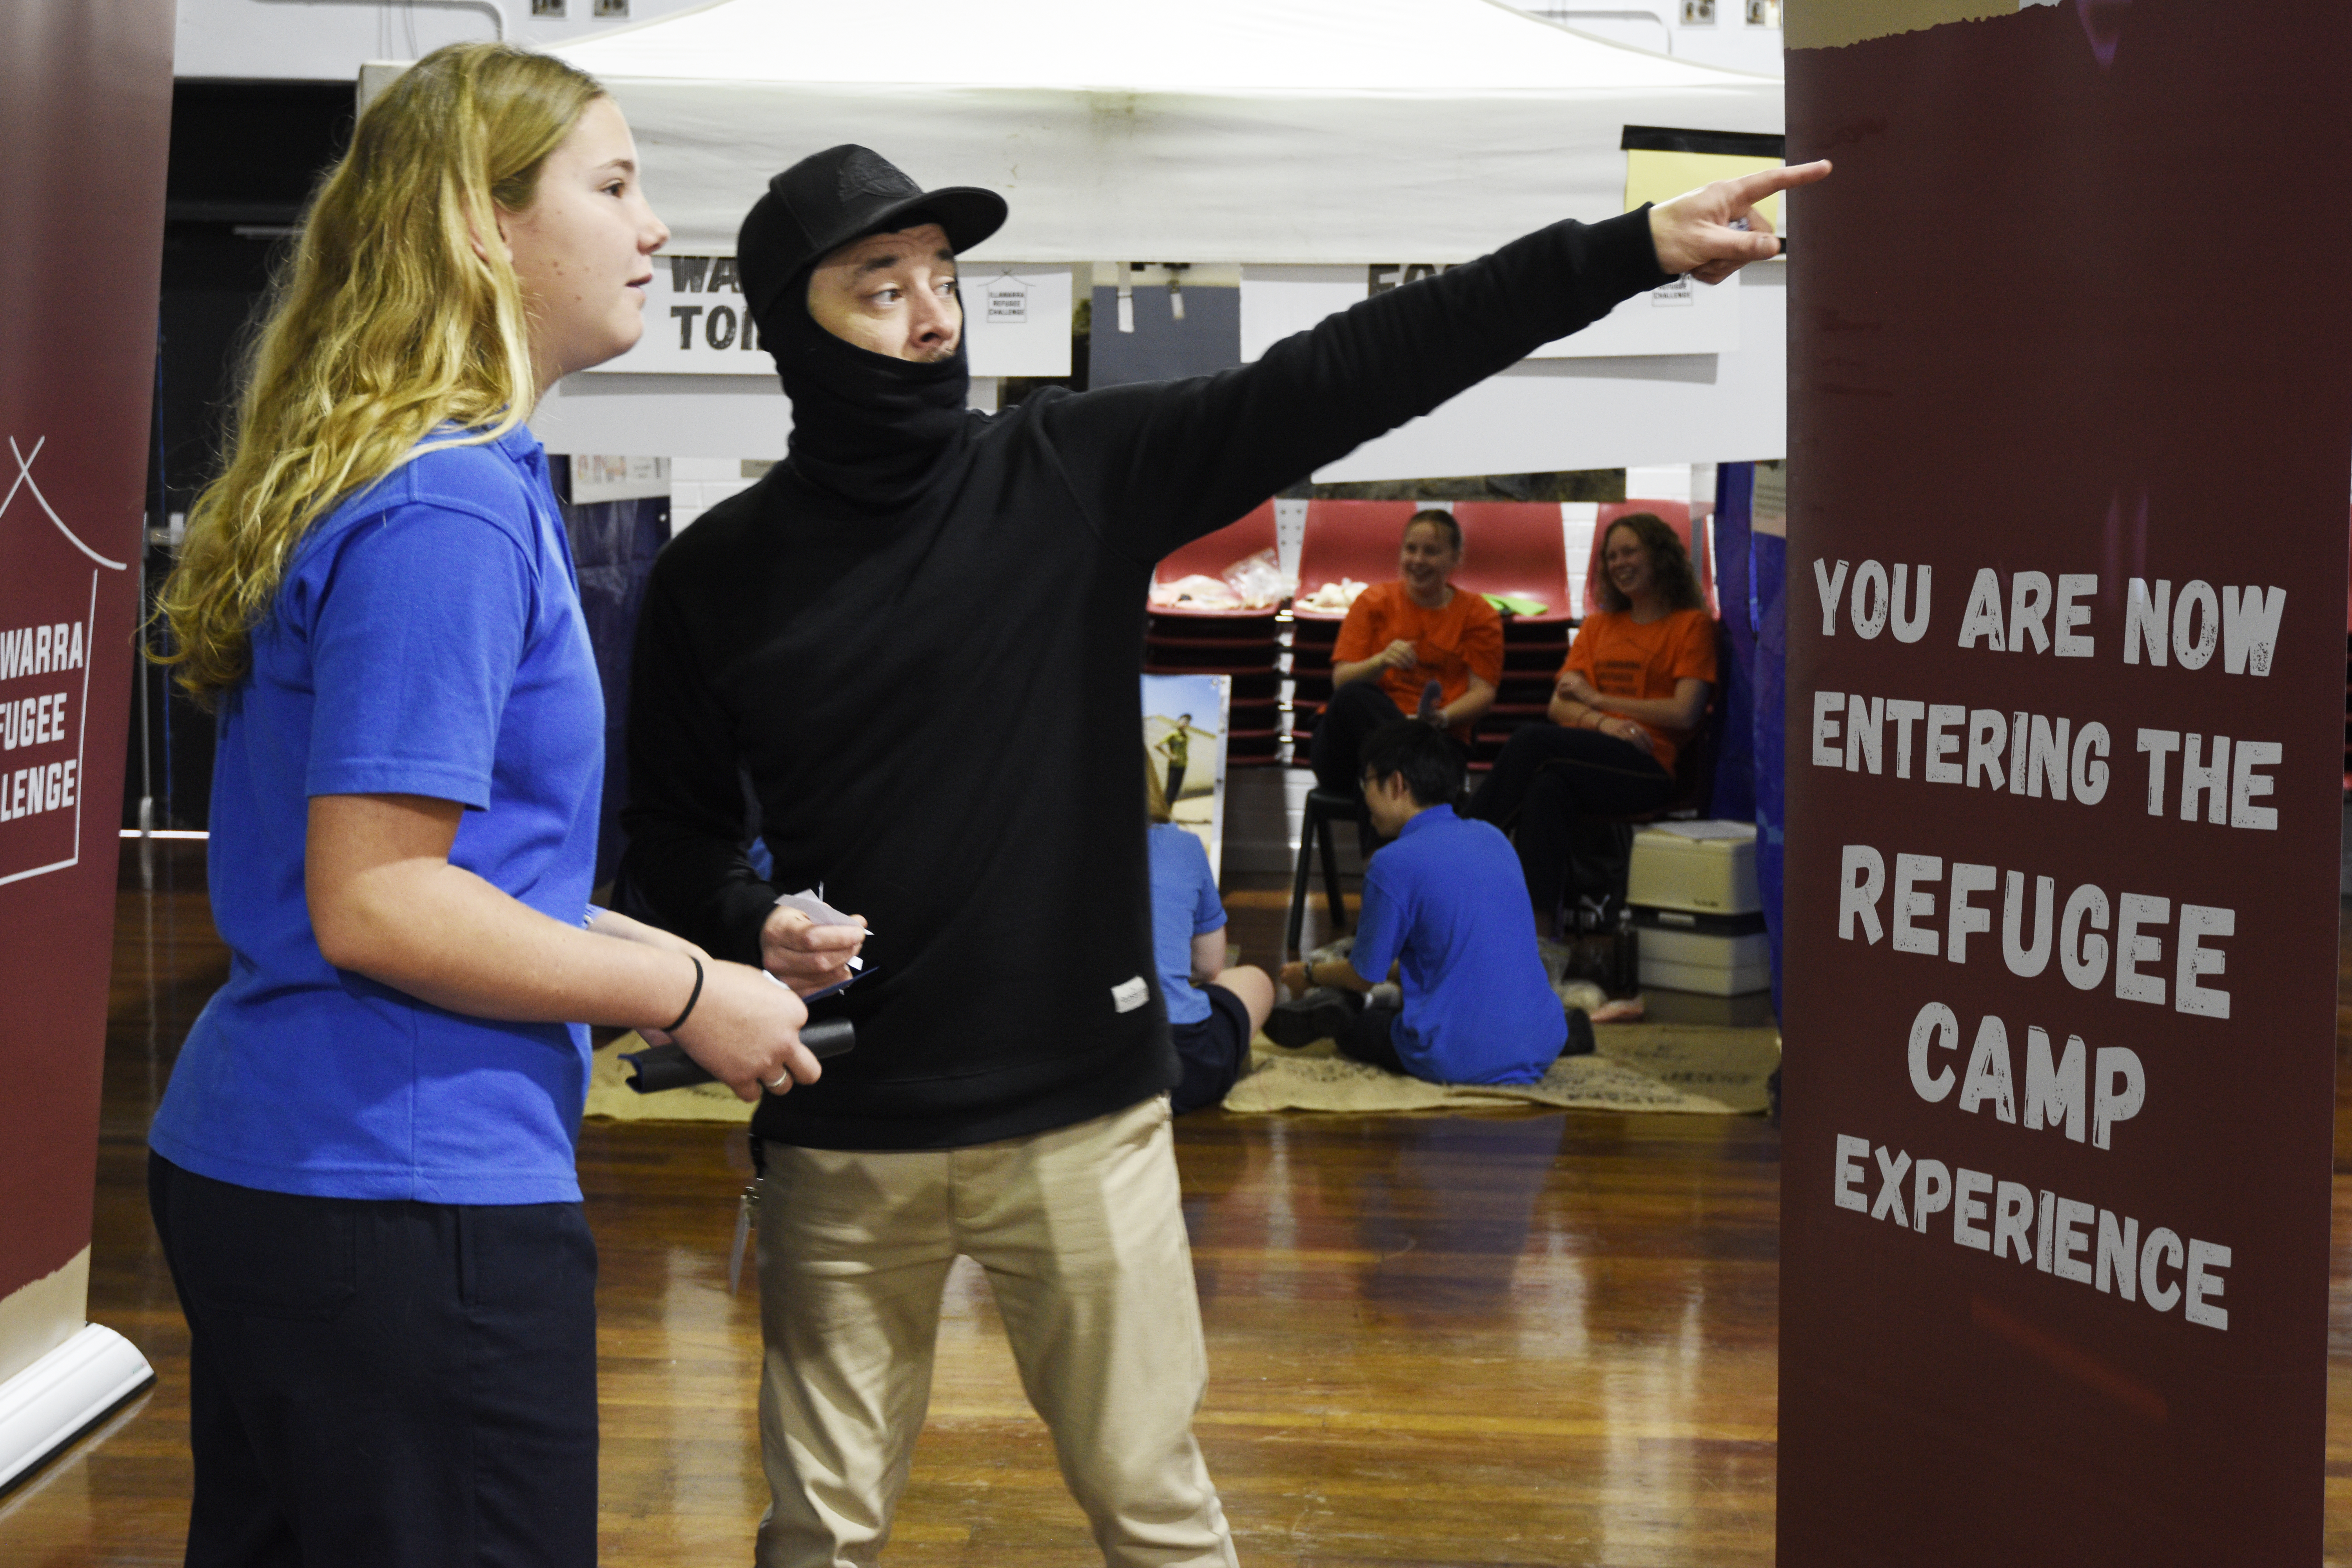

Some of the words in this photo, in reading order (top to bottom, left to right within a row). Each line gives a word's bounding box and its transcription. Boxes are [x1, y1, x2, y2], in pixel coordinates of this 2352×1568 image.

[671, 305, 760, 350] TOI
[1814, 558, 1932, 643] YOU
[1958, 568, 2098, 657] ARE
[2123, 577, 2287, 677] NOW
[1812, 691, 2110, 805] ENTERING
[2137, 728, 2282, 830] THE
[1838, 845, 2235, 1019] REFUGEE
[1908, 1002, 2145, 1151] CAMP
[1835, 1134, 2231, 1330] EXPERIENCE
